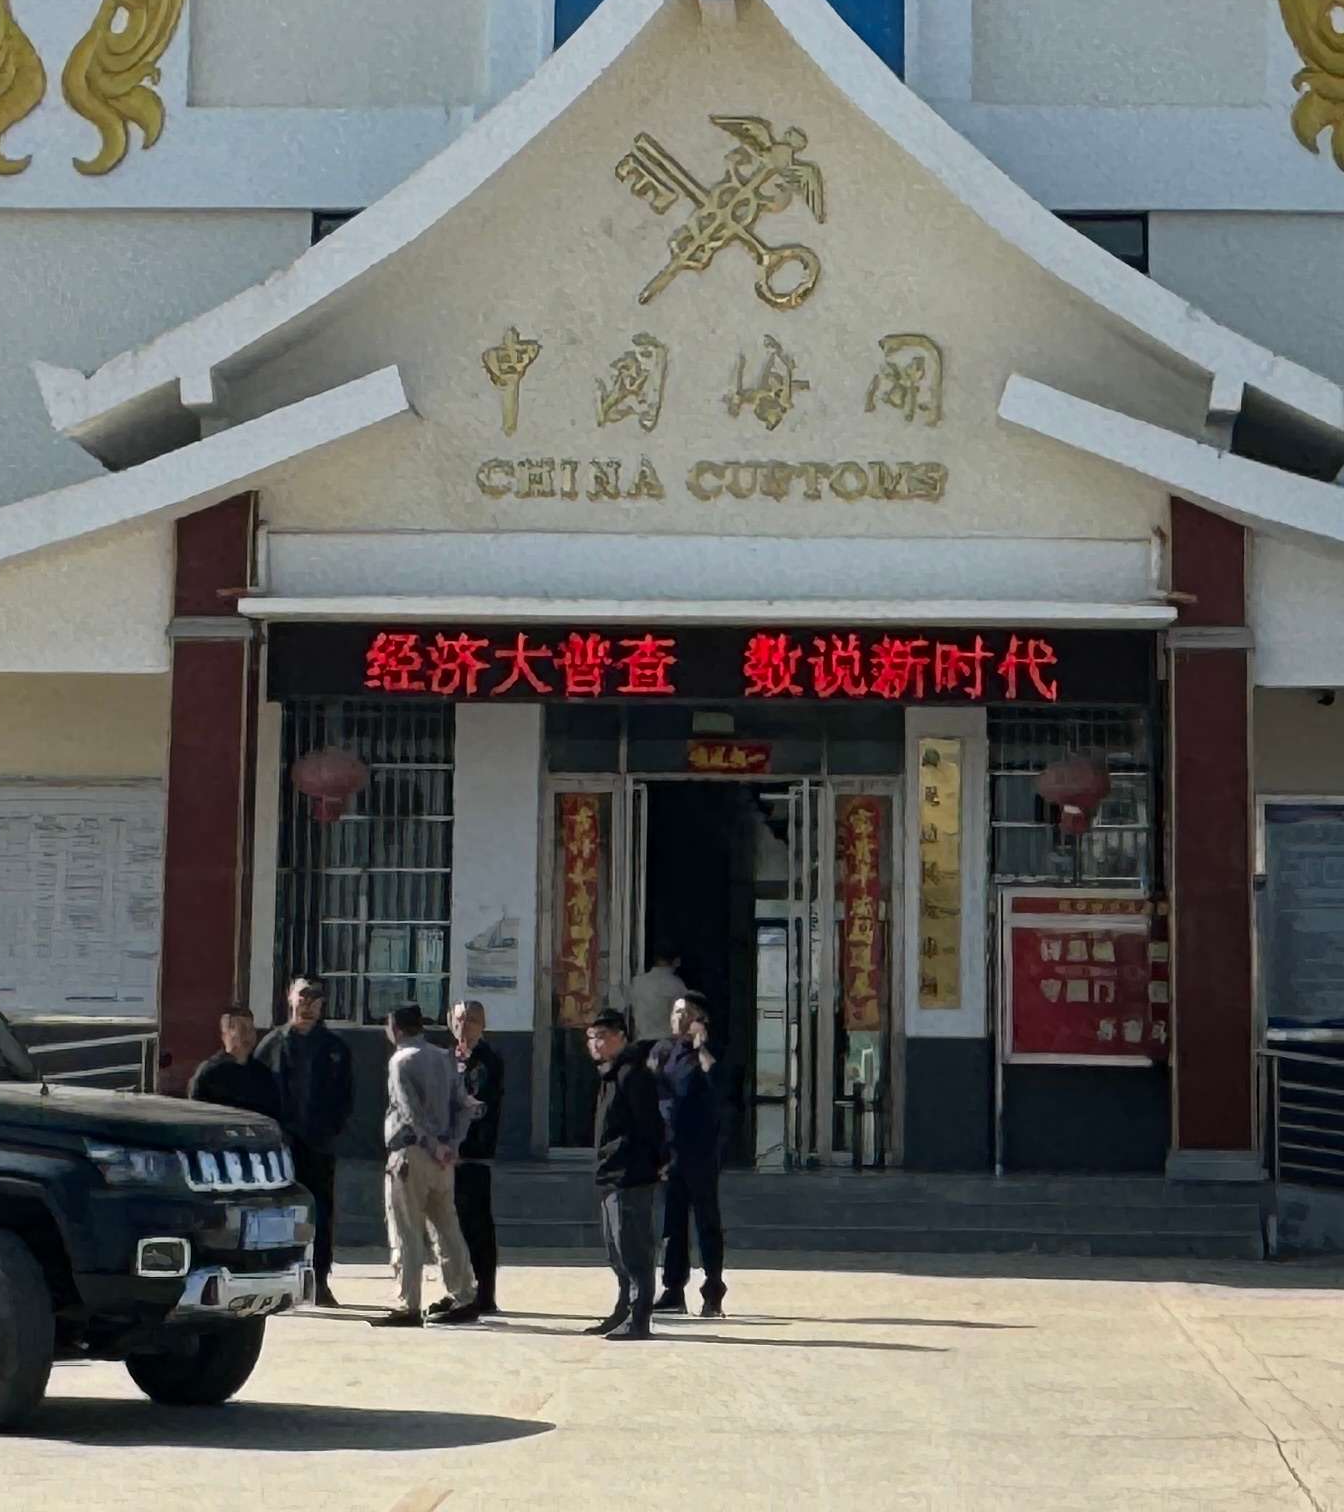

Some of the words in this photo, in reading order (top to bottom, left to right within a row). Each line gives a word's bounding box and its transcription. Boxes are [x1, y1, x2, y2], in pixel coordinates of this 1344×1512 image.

[475, 454, 665, 502] CHINA
[685, 458, 949, 502] CUSTOMS
[364, 631, 678, 697] 经济大普查
[742, 632, 1059, 701] 数说新时代
